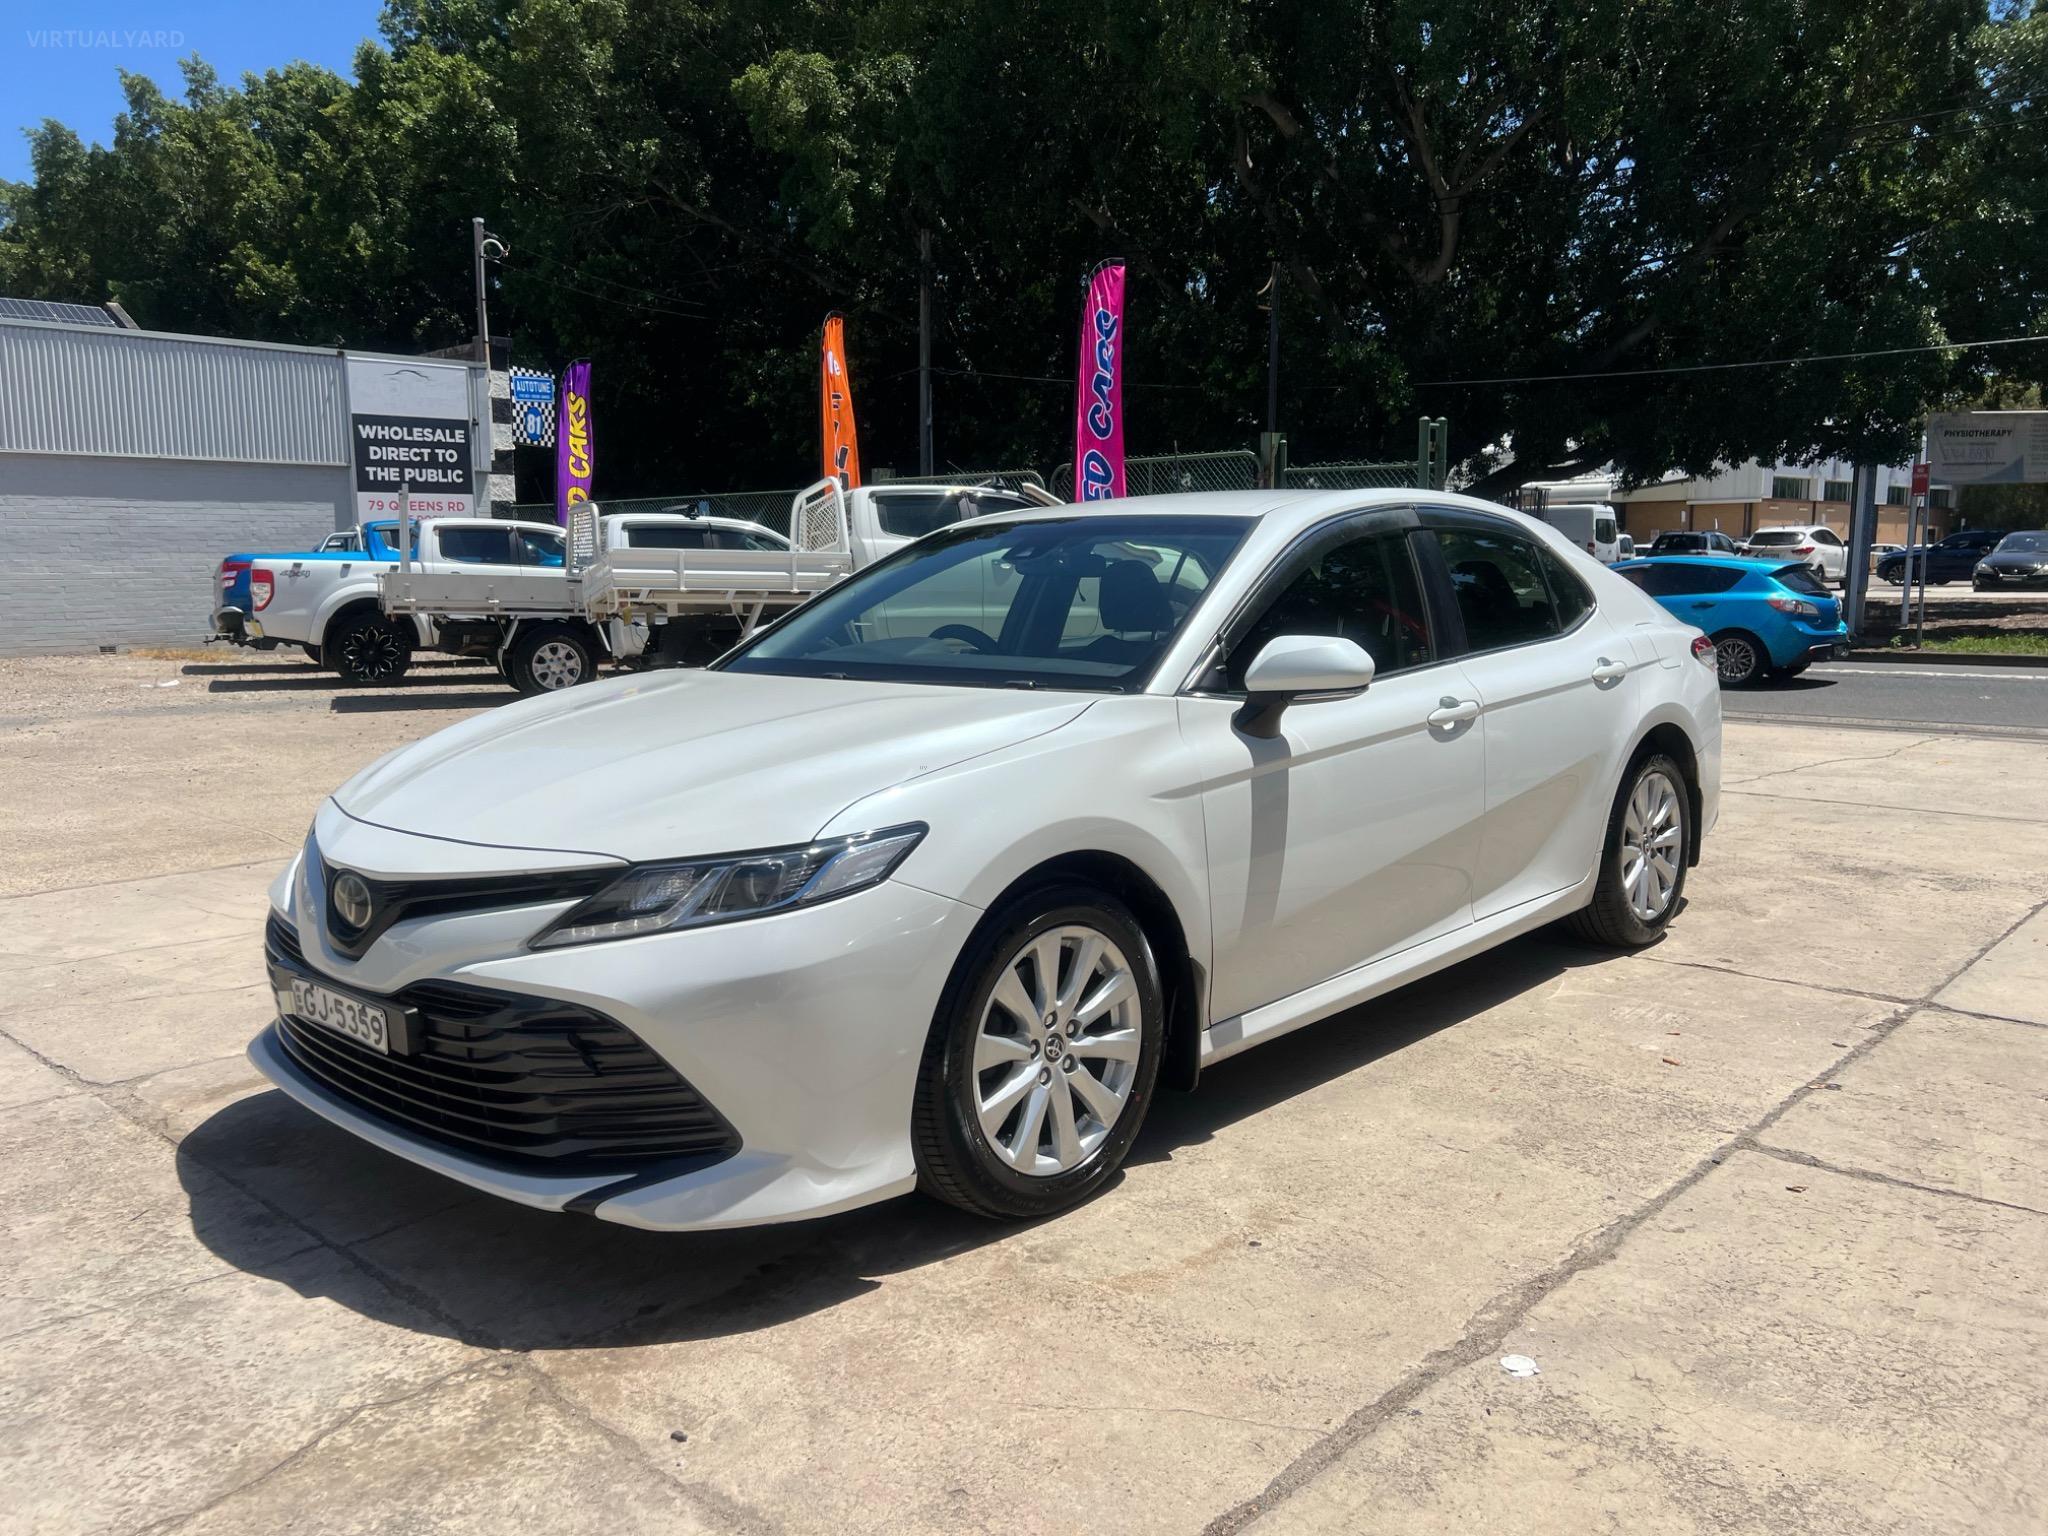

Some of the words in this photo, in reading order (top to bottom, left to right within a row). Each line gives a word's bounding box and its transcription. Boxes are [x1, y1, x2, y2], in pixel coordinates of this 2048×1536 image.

[516, 380, 551, 393] AUTOTUNE
[526, 413, 541, 435] 81
[358, 424, 465, 443] WHOLESALE
[1943, 429, 2013, 438] PHYSIOTHERAPY
[369, 446, 431, 461] DIRECT
[435, 449, 458, 463] TO
[365, 466, 400, 481] THE
[404, 468, 464, 483] PUBLIC
[368, 500, 384, 511] 79
[388, 500, 443, 512] QEENS
[447, 501, 465, 512] RD
